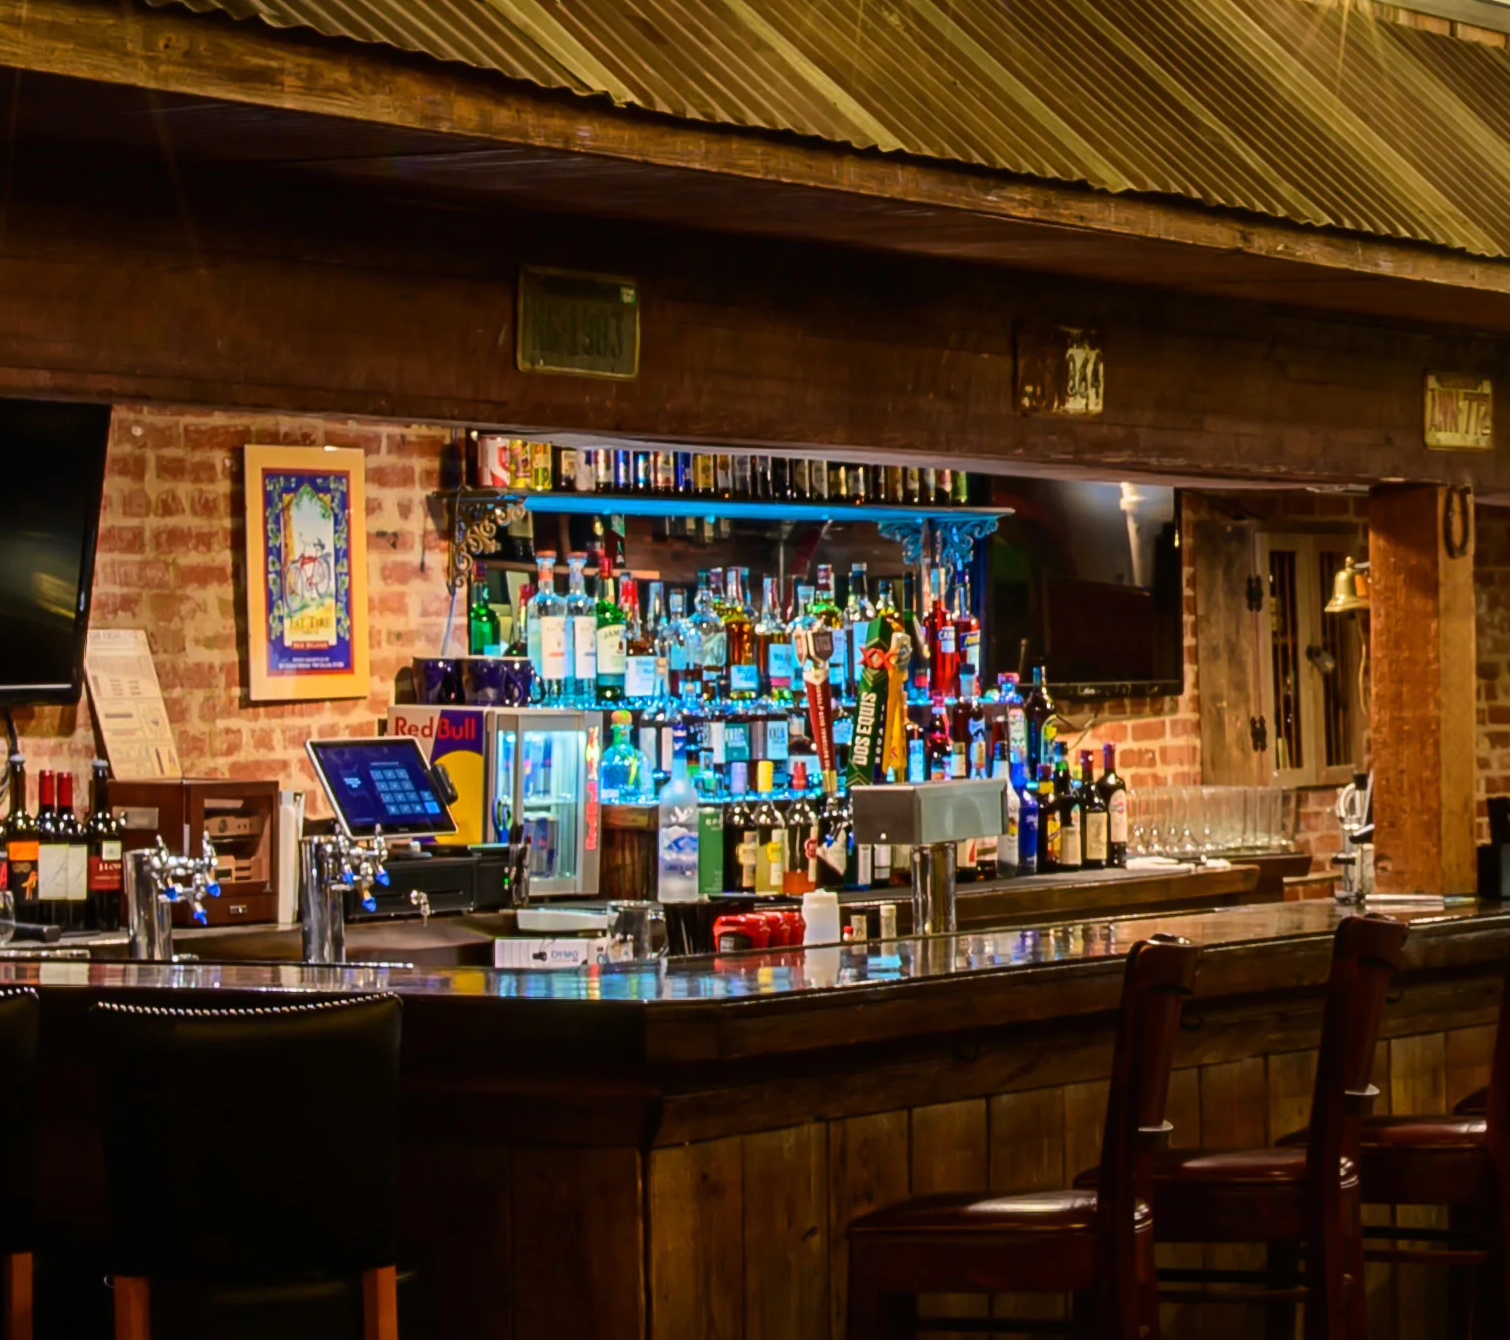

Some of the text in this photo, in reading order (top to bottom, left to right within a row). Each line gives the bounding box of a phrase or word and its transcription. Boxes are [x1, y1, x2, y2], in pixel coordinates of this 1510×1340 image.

[394, 716, 476, 740] Red Bull
[852, 691, 877, 766] DOS EQUIS
